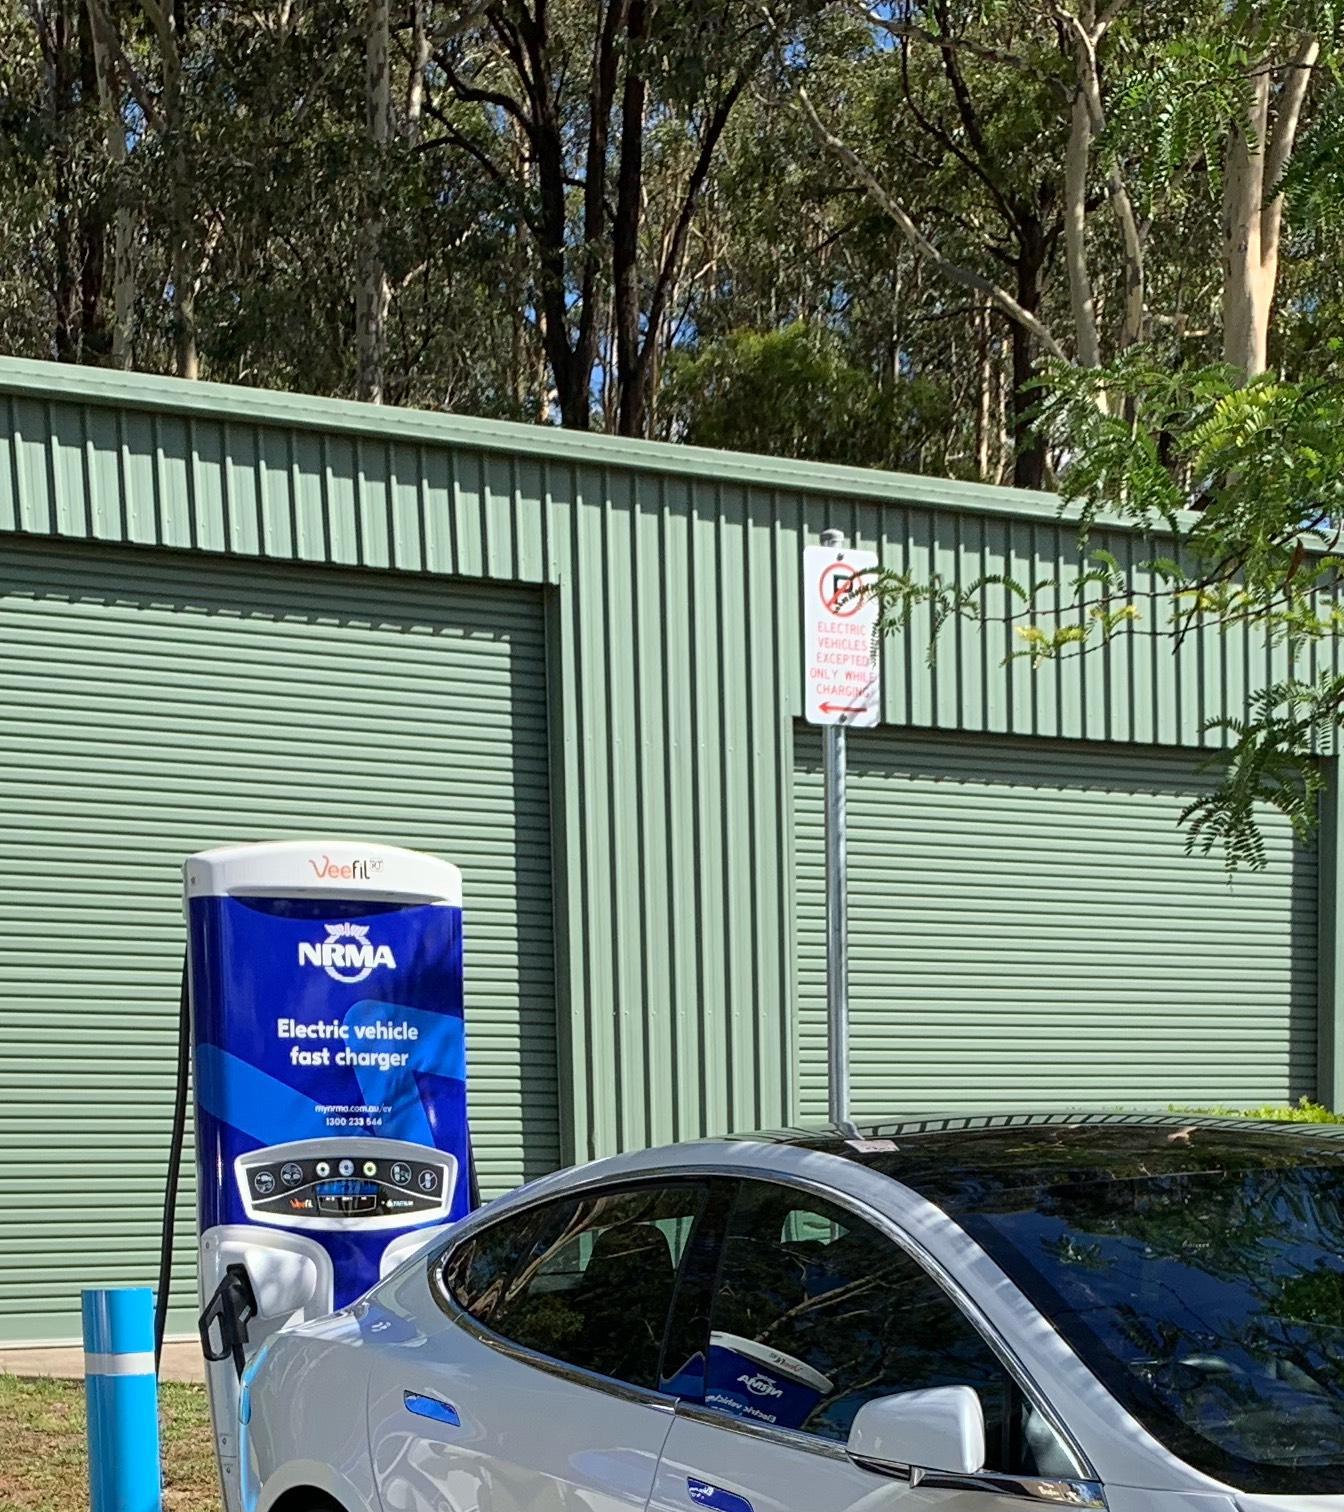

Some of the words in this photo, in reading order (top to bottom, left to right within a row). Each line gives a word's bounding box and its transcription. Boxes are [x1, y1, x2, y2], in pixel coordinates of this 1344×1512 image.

[817, 621, 867, 635] ELECTRIC
[818, 637, 868, 651] VEHICLES
[817, 652, 869, 667] EXCEPTED
[810, 667, 838, 679] ONLY
[844, 671, 876, 684] WHILE
[308, 855, 371, 880] Veefil
[298, 942, 396, 969] NRMA
[277, 1018, 350, 1039] Electric
[354, 1020, 419, 1040] vehicle
[290, 1046, 330, 1066] fast
[335, 1047, 409, 1071] charger
[326, 1117, 346, 1127] 1300
[348, 1117, 364, 1127] 233
